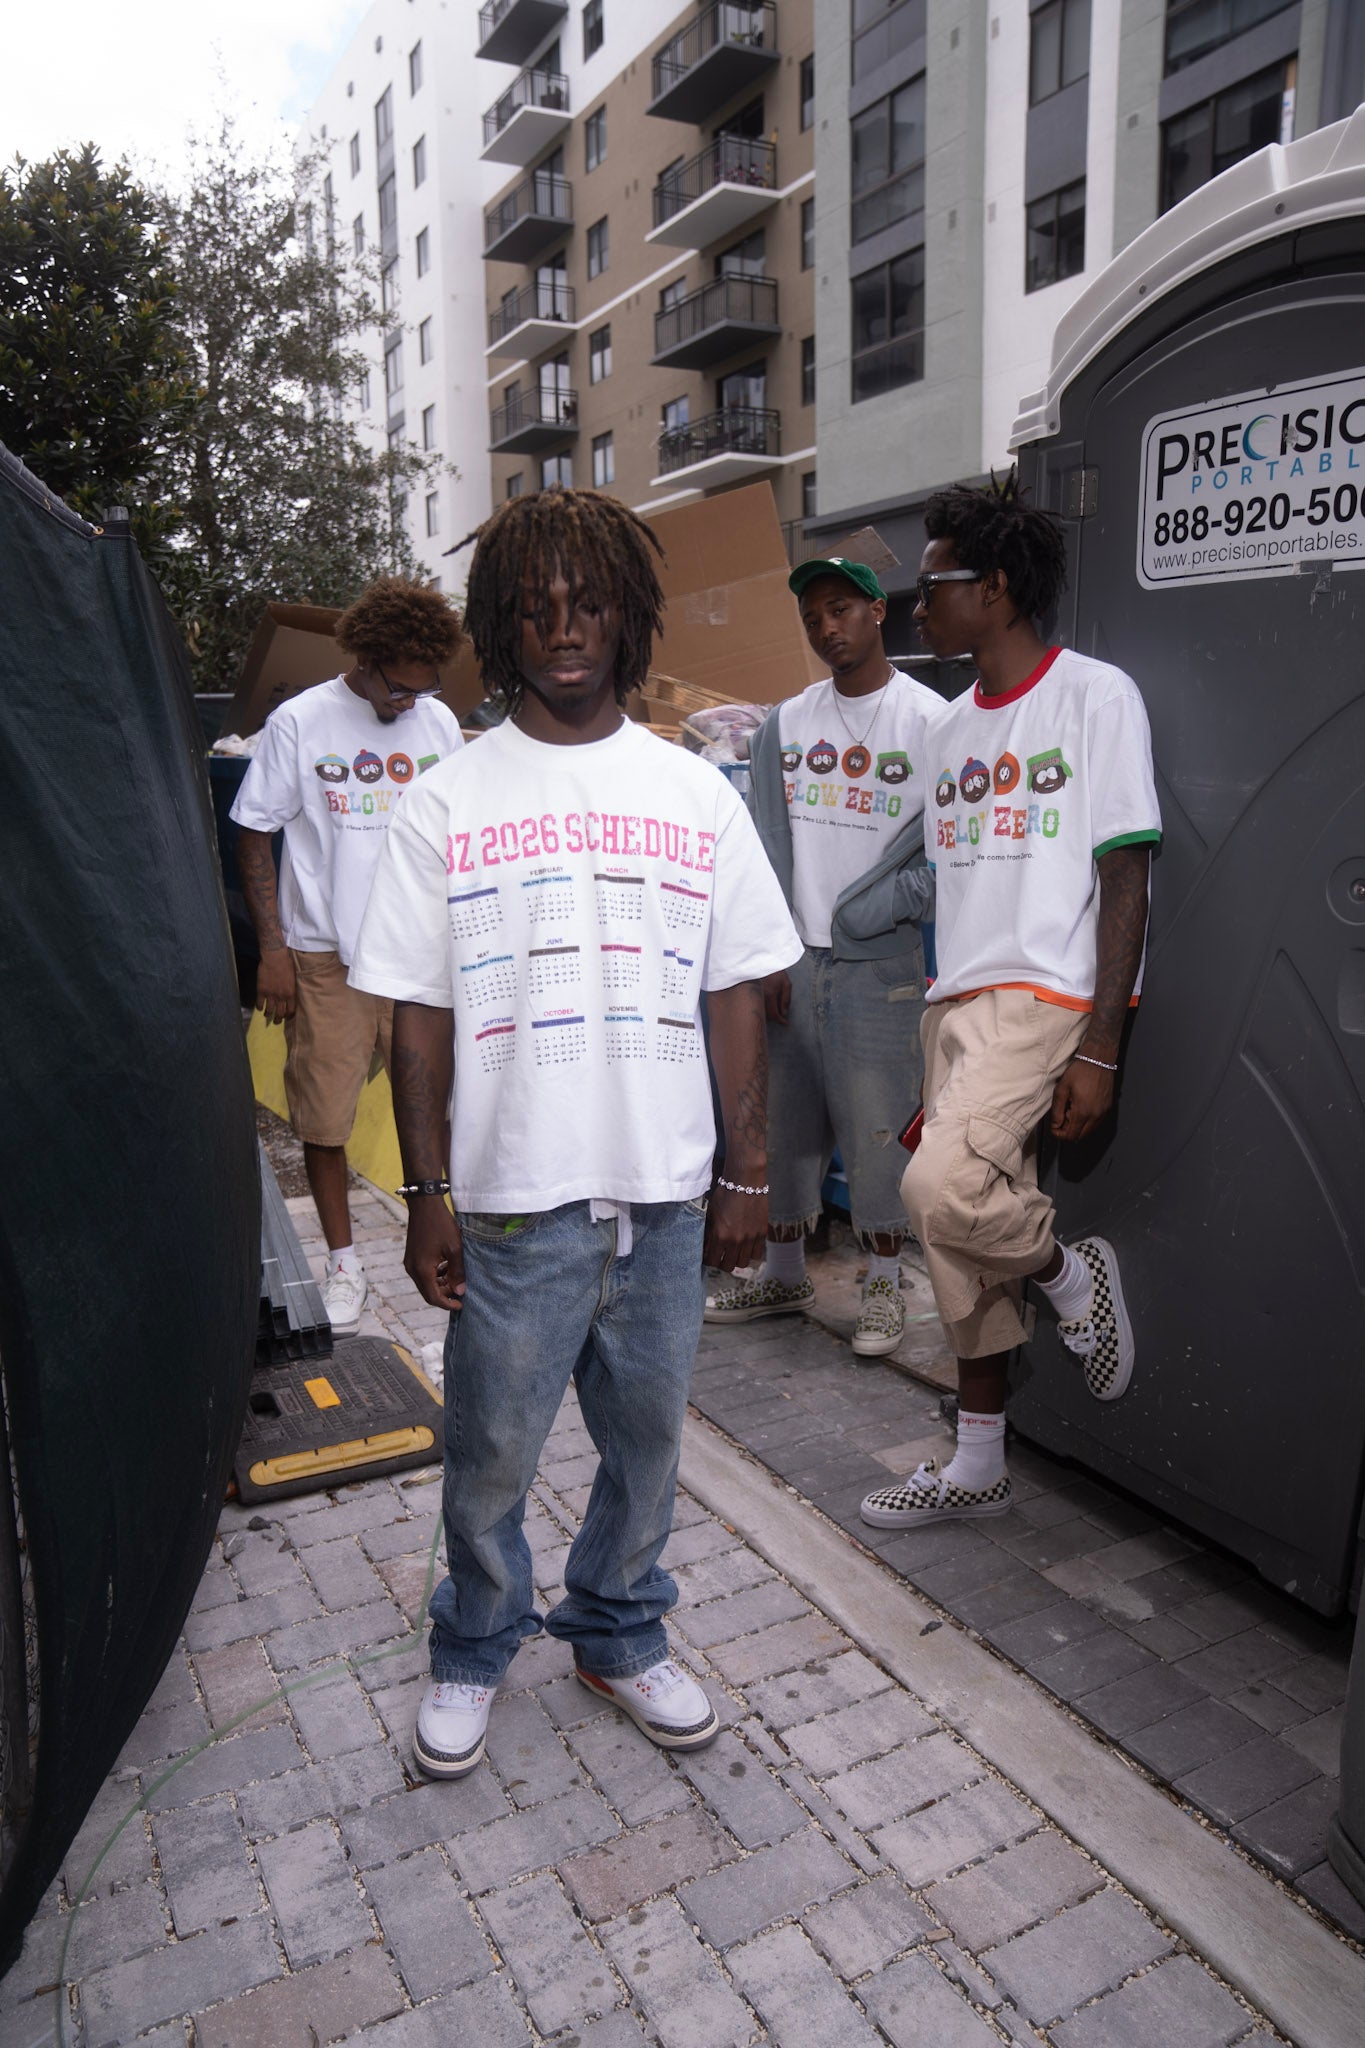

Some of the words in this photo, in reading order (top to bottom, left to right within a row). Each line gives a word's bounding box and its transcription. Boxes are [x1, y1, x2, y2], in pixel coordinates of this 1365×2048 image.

[1191, 448, 1361, 494] PORTABL
[1153, 483, 1365, 547] 888-920-50
[325, 790, 393, 816] BELOW
[784, 778, 844, 807] ELOW
[845, 786, 902, 818] ZERO
[480, 813, 559, 867] 2026
[564, 811, 716, 873] SCHEDULE
[993, 804, 1060, 839] ZERO
